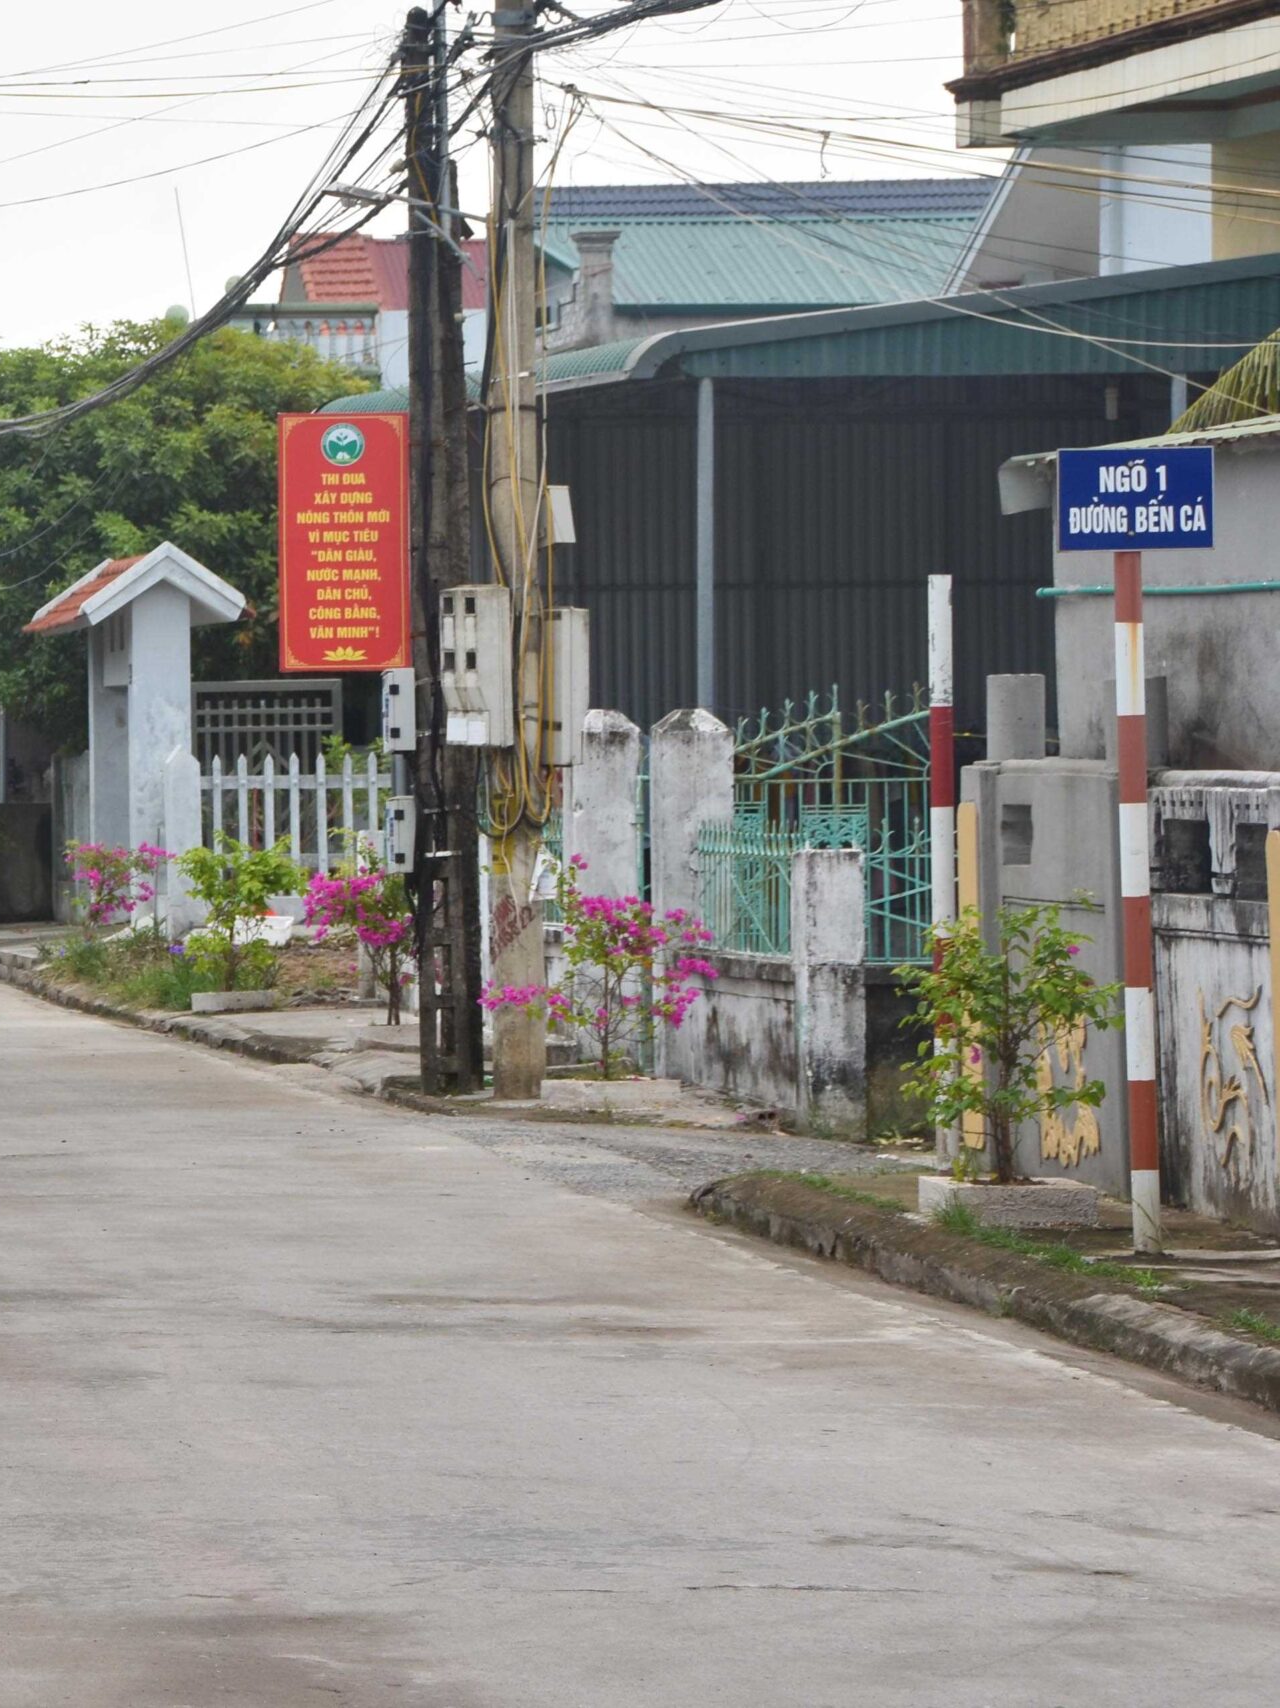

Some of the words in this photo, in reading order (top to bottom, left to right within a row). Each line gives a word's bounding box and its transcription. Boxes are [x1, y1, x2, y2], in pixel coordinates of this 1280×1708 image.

[322, 473, 339, 485] THI
[342, 473, 366, 485] ĐUA
[1099, 459, 1148, 493] NGÕ
[1155, 465, 1167, 492] 1
[314, 490, 337, 505] XÂY
[340, 491, 373, 506] DỰNG
[297, 510, 330, 524] NÔNG
[333, 509, 364, 523] THÔN
[367, 509, 390, 522] MỚI
[1069, 496, 1128, 534] ĐƯỜNG
[1135, 494, 1174, 533] BẾN
[1179, 496, 1207, 532] CÁ
[308, 529, 320, 543] VÌ
[323, 530, 350, 545] MỤC
[353, 529, 379, 542] TIÊU
[345, 547, 377, 562] GIÀU,
[306, 568, 339, 581] NƯỚC
[342, 569, 381, 583] MẠNH,
[317, 586, 342, 600] DÂN
[344, 584, 372, 601] CHỦ,
[308, 606, 341, 620] CÔNG
[344, 603, 381, 620] BẰNG,
[309, 625, 334, 639] VĂN
